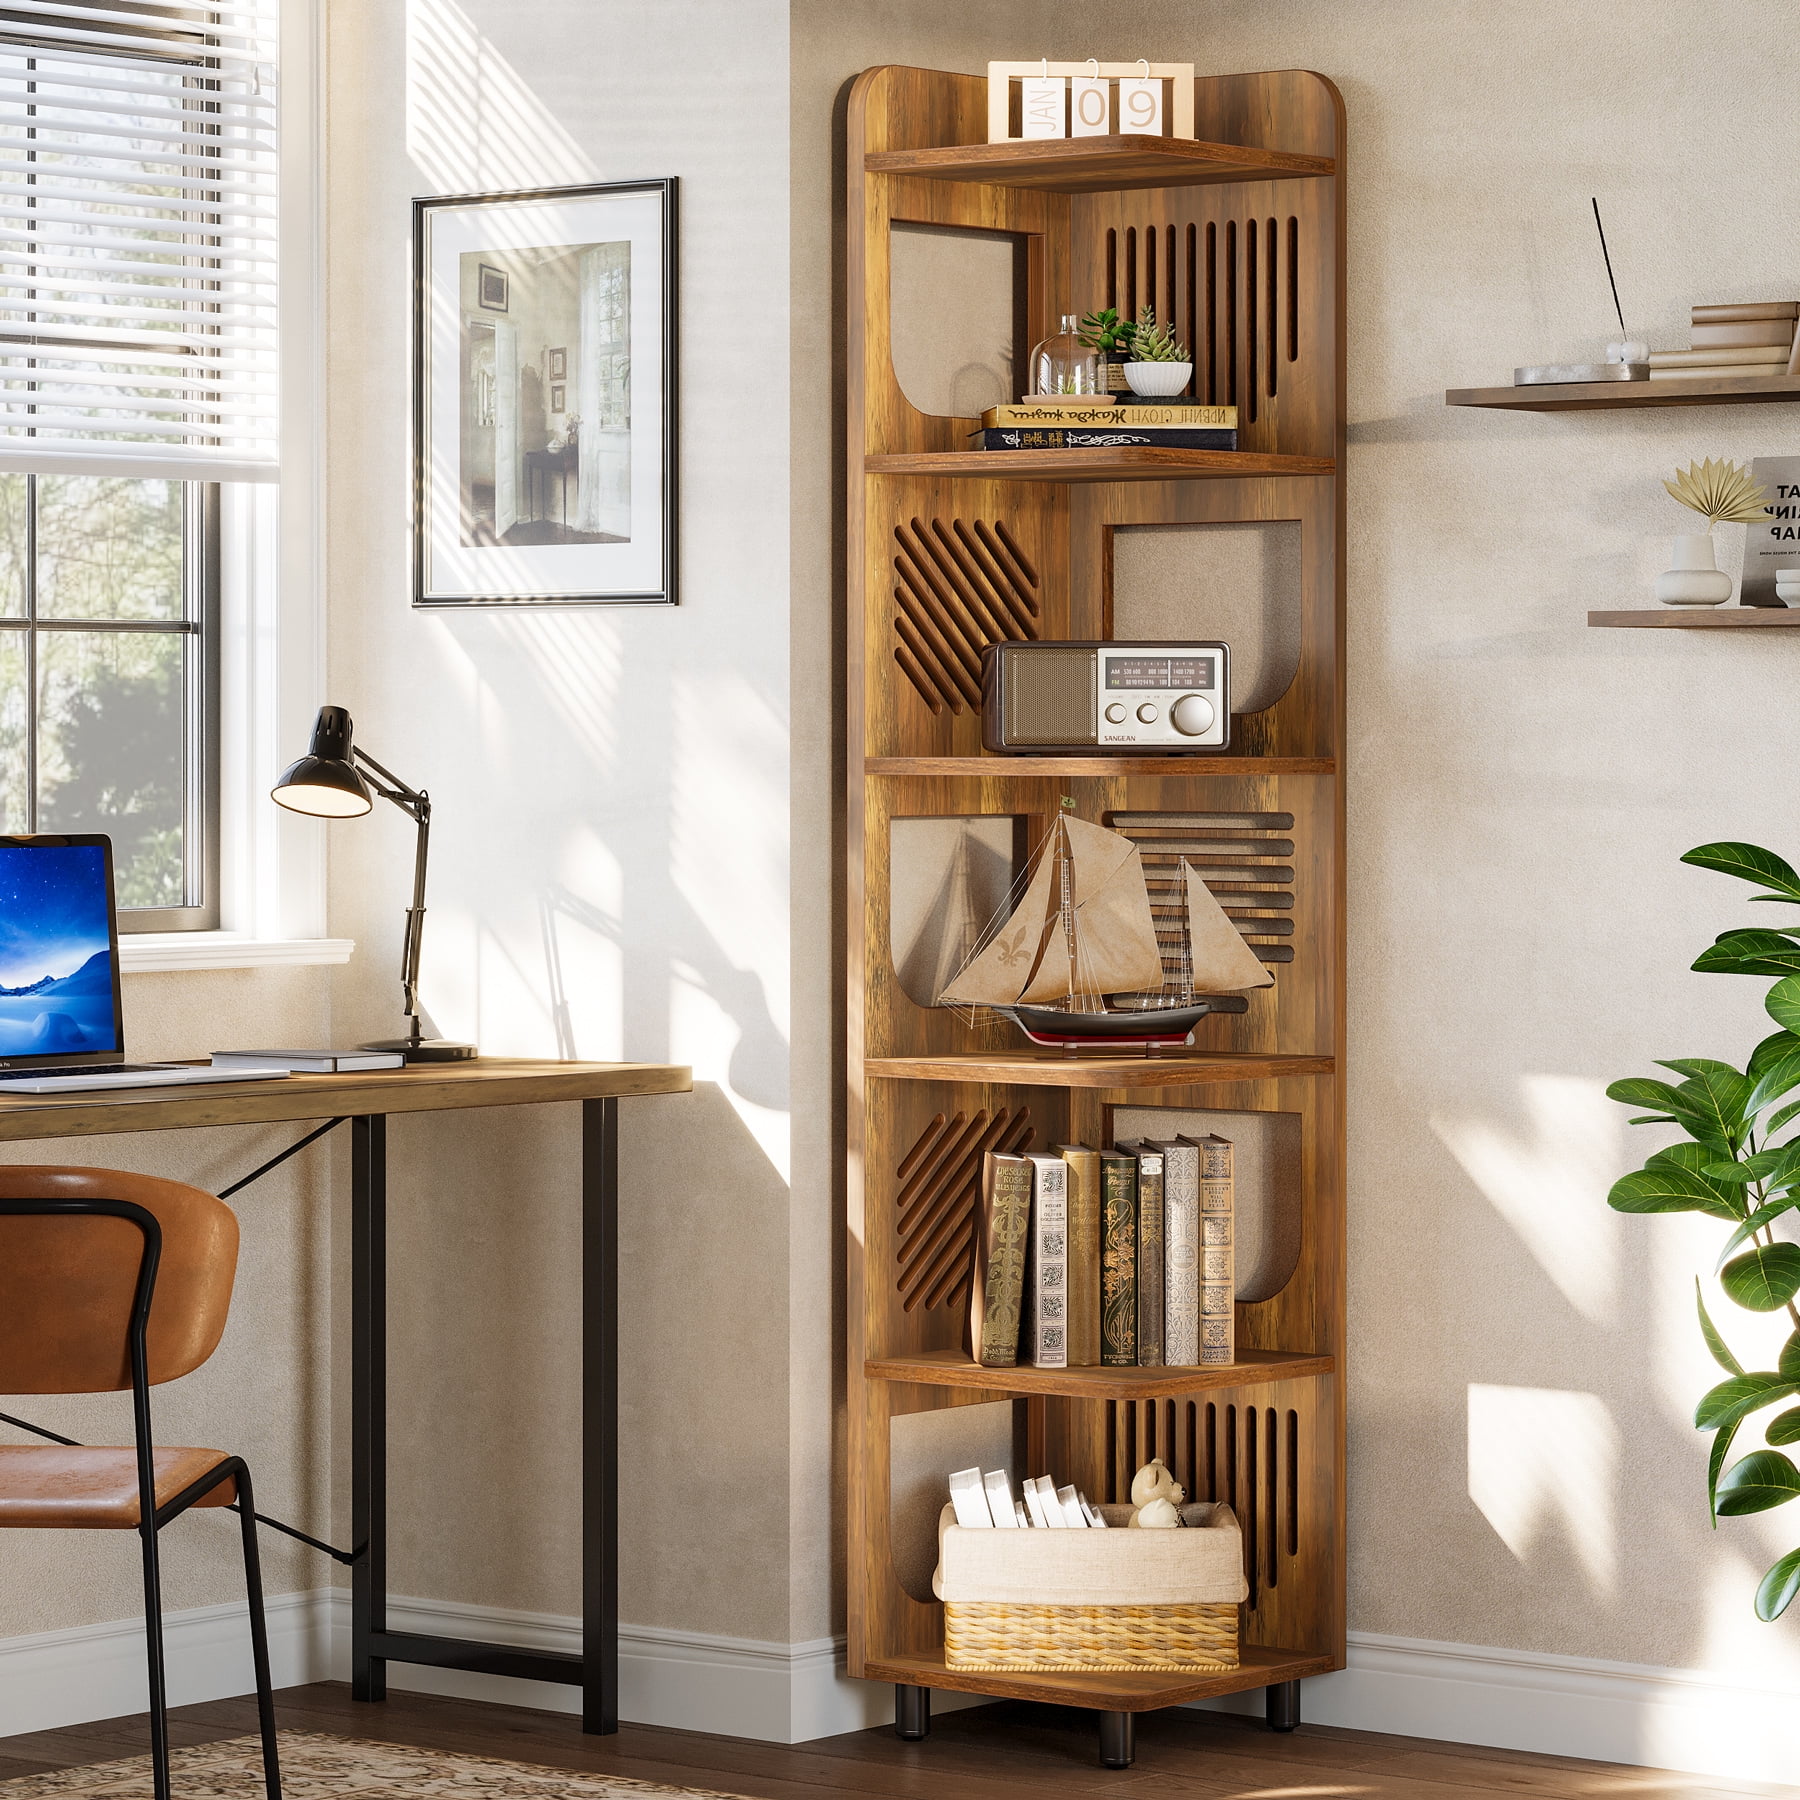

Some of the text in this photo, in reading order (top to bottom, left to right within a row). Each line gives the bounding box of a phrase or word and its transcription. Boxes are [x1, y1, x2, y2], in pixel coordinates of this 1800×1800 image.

[1029, 90, 1057, 132] JAN
[1007, 409, 1226, 425] ИРВИНГ СТОУН Жажда жизни
